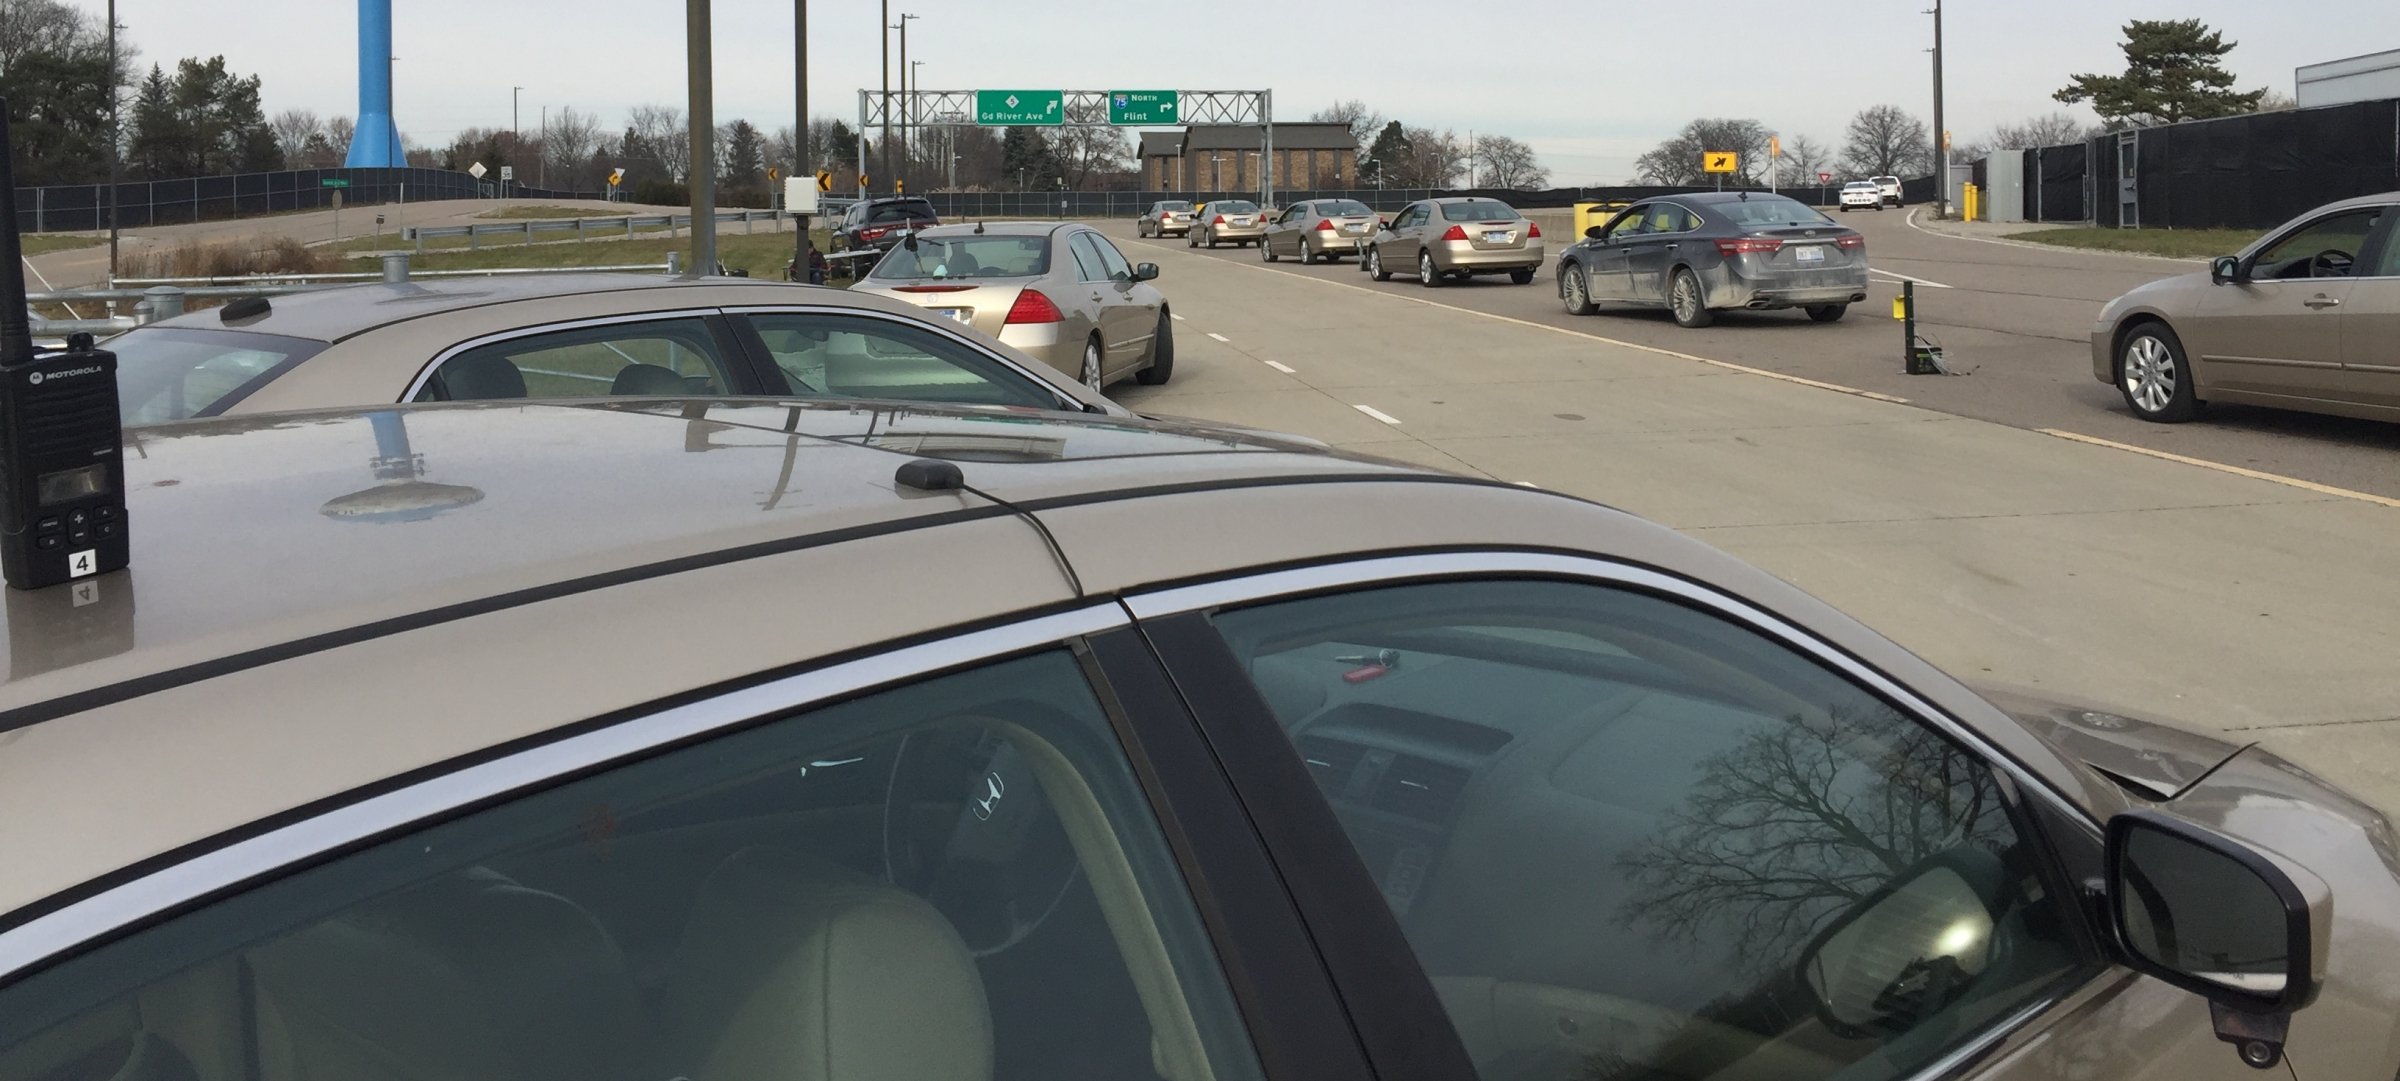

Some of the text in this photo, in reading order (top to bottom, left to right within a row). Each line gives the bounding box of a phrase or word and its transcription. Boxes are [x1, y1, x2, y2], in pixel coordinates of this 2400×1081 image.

[1115, 97, 1127, 106] 75
[981, 112, 1043, 120] Gd River Ave
[1124, 112, 1148, 120] Flint
[46, 366, 102, 380] MOTOROLA
[76, 555, 89, 571] 4
